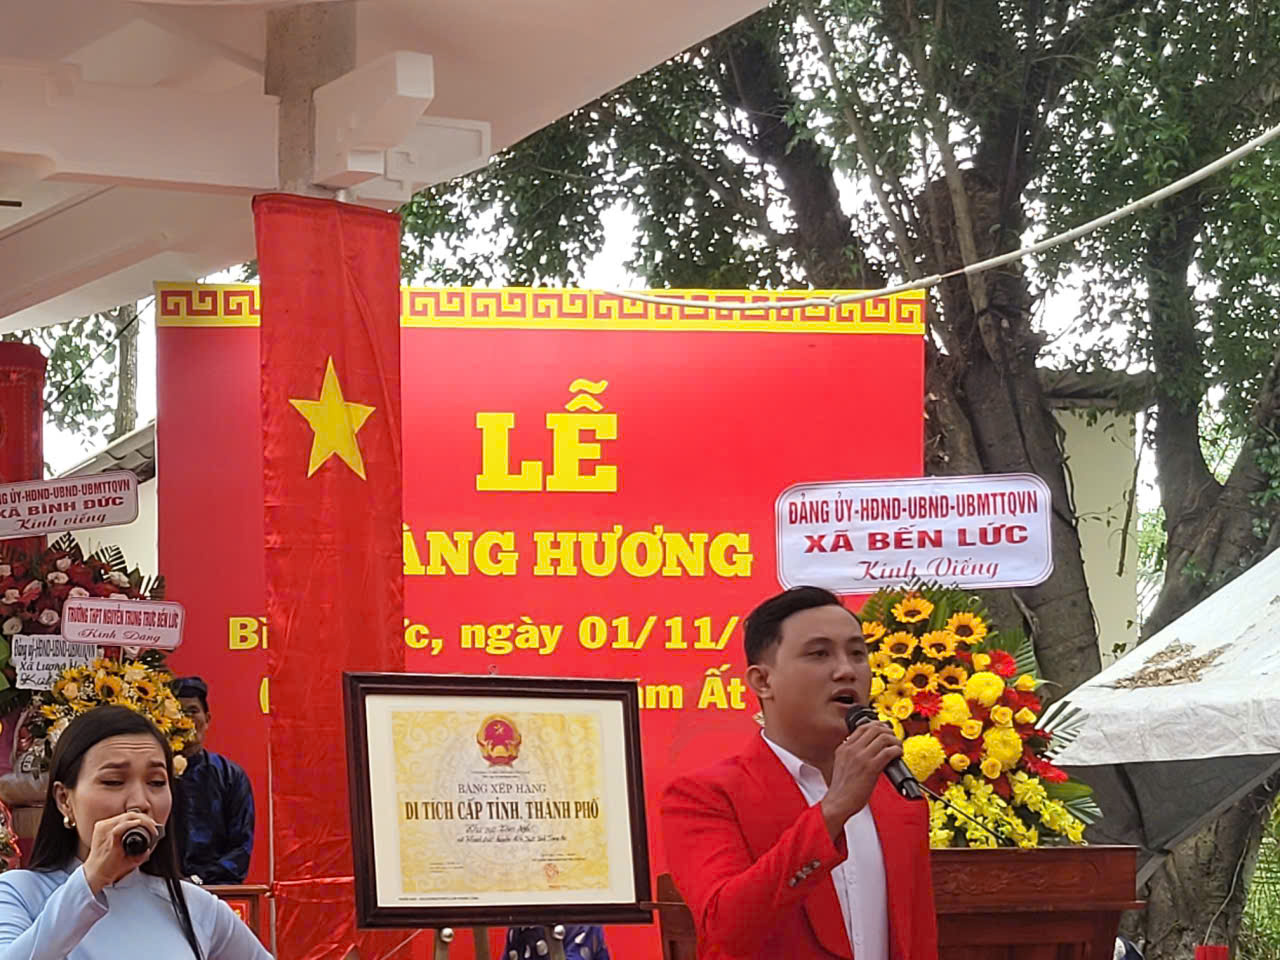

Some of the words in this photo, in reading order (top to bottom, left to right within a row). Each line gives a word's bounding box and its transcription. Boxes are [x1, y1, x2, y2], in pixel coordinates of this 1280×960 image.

[476, 378, 617, 492] LỄ
[28, 501, 76, 516] BÌNH
[83, 496, 124, 510] ĐỨC
[789, 492, 830, 525] ĐẢNG
[534, 524, 754, 577] HƯƠNG
[805, 529, 854, 553] XÃ
[868, 525, 943, 550] BẾN
[958, 522, 1029, 547] LỨC
[927, 557, 1000, 578] Viếng
[229, 617, 268, 650] Bì
[404, 618, 443, 655] c,
[461, 616, 562, 655] ngày
[579, 616, 739, 650] 01/11/
[698, 664, 746, 710] Ất
[405, 802, 419, 820] DI
[422, 799, 454, 820] TÍCH
[458, 797, 483, 820] CẤP
[526, 799, 571, 819] THÀNH
[574, 797, 600, 819] PHỐ
